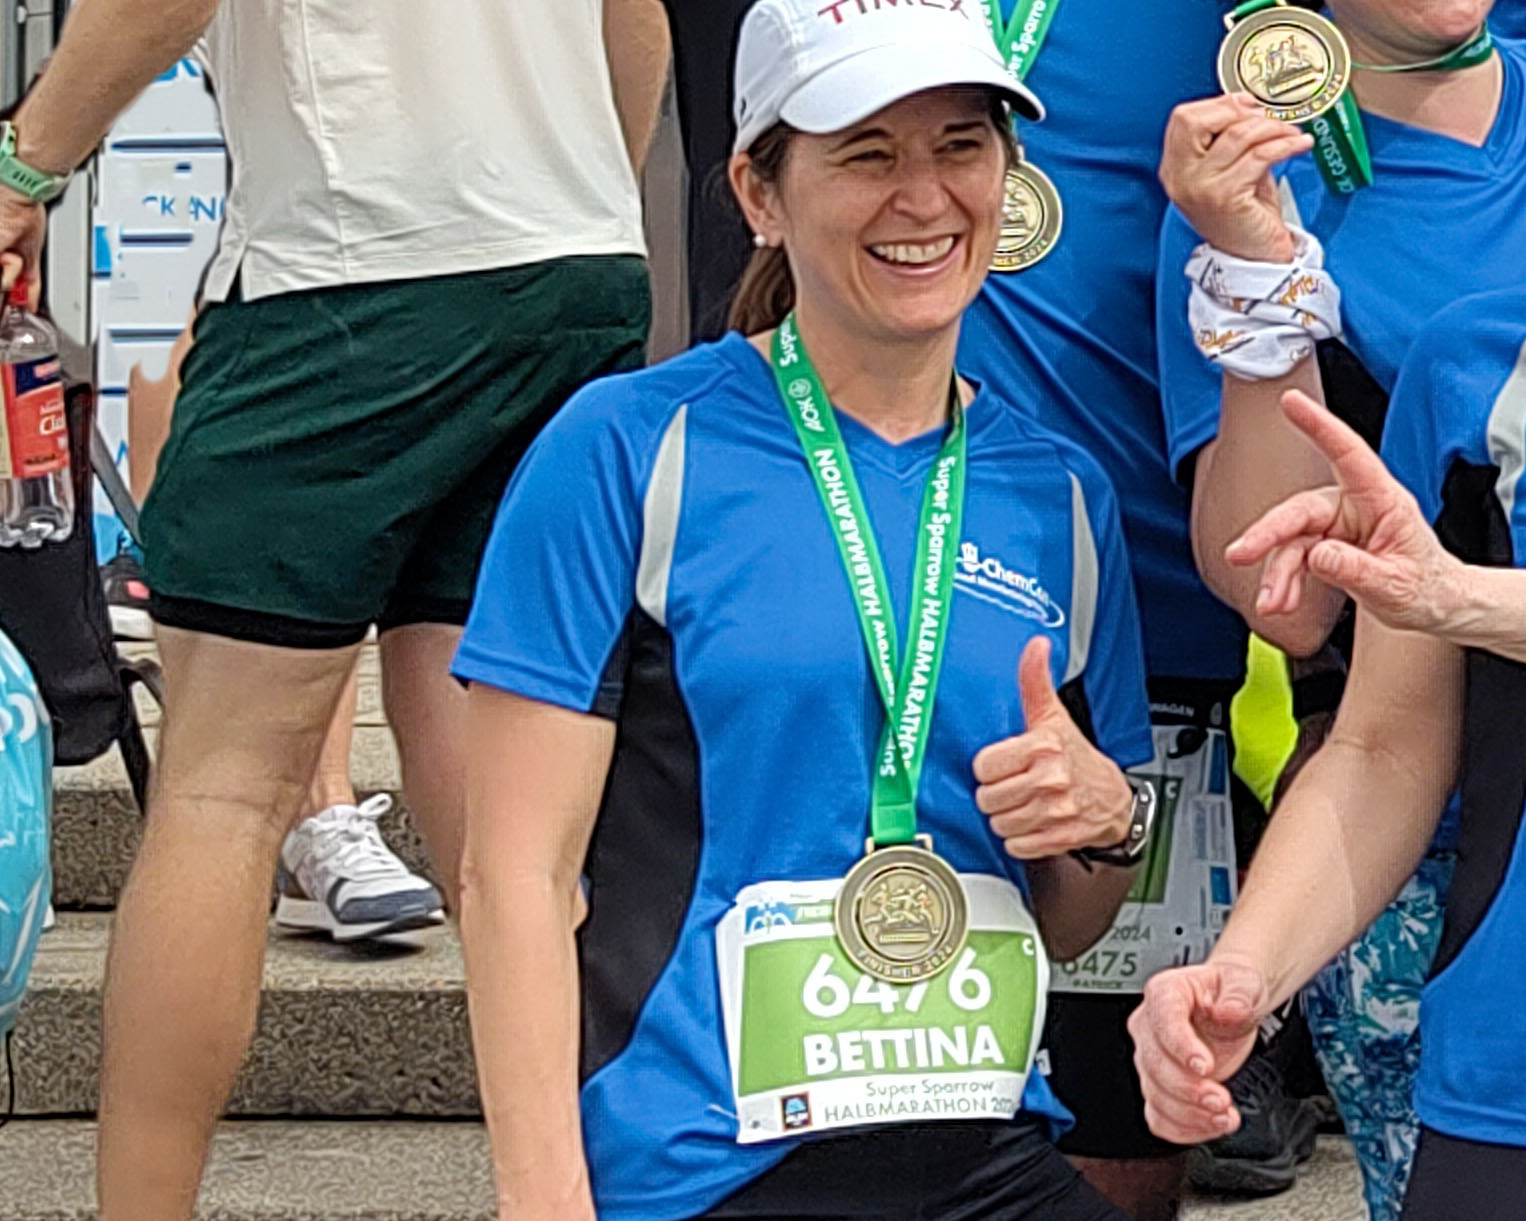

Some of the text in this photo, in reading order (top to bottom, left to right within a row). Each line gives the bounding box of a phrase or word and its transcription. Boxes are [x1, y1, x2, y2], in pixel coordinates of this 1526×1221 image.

[795, 397, 826, 433] AOK
[813, 448, 884, 615] HALBMARATHON
[898, 455, 956, 769] Super Sparrow HALBMARATHO
[804, 1024, 1005, 1076] BETTINA
[825, 1097, 987, 1122] HALBMARATHON
[866, 1078, 994, 1097] Super Sparrow
